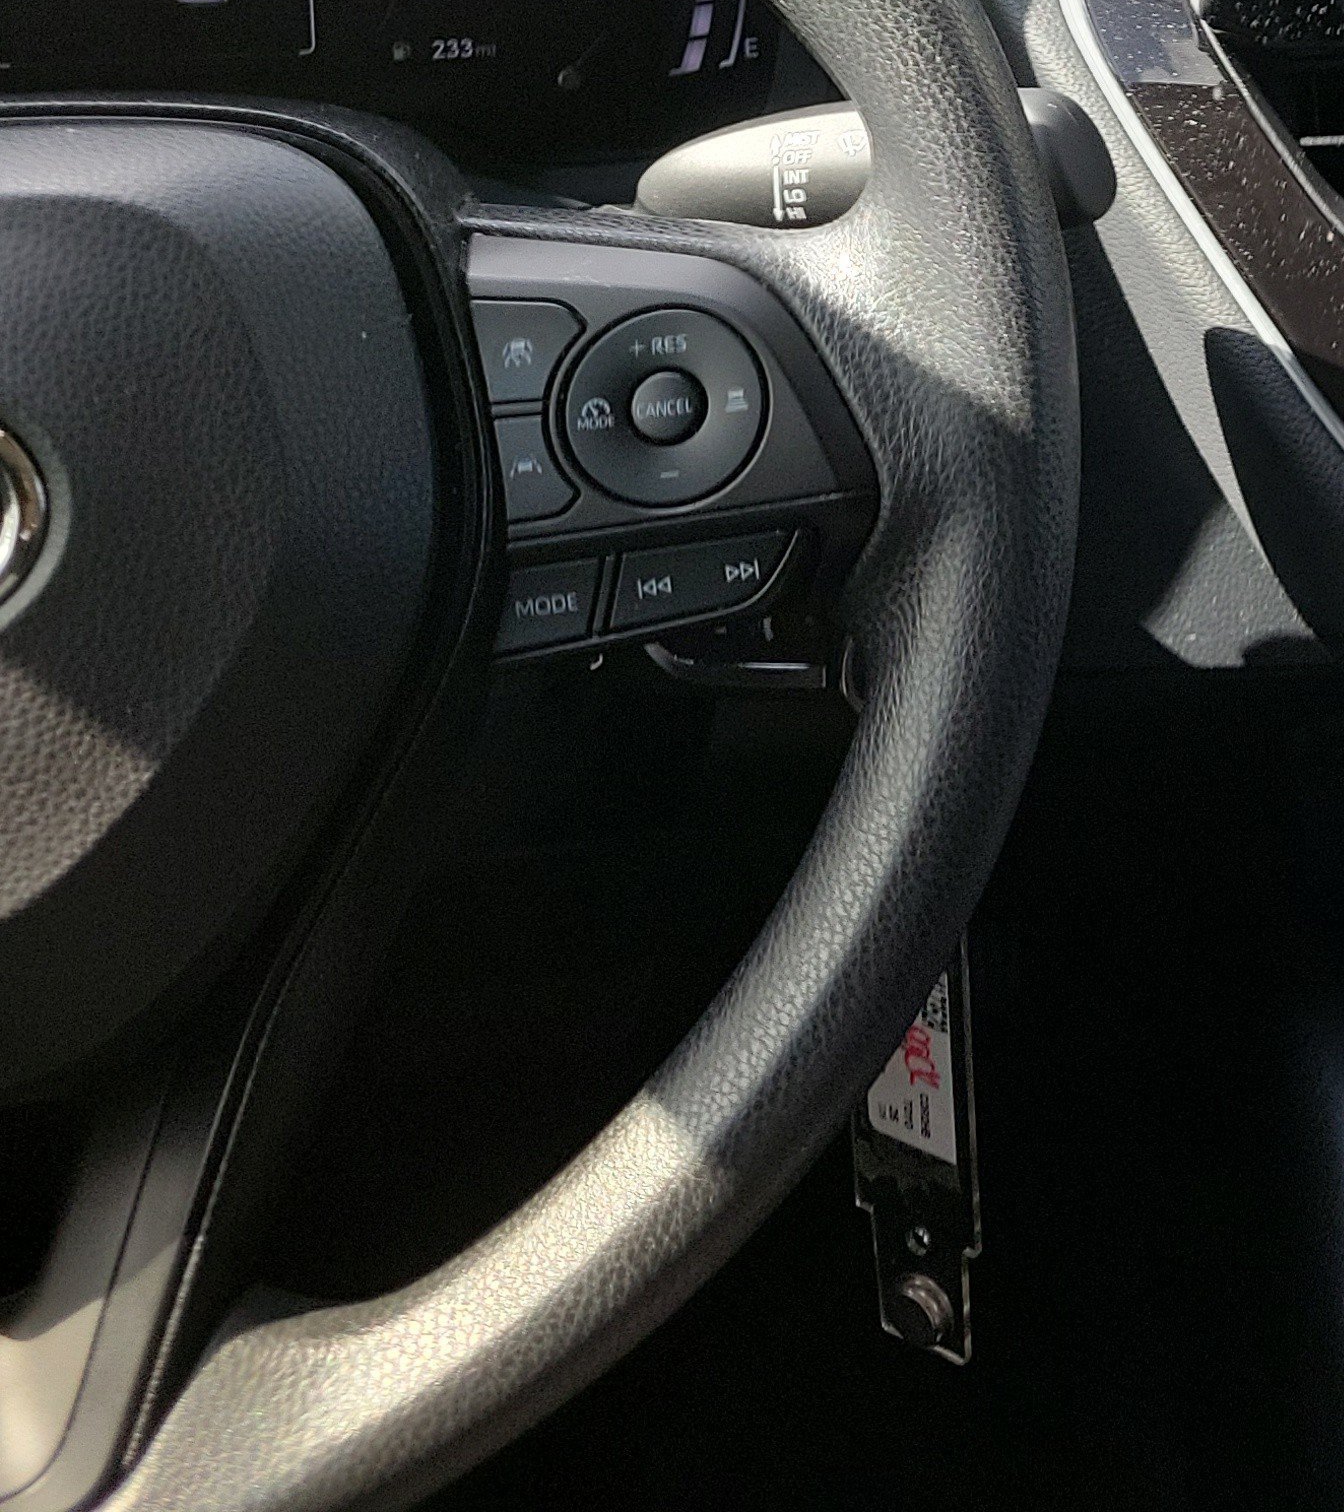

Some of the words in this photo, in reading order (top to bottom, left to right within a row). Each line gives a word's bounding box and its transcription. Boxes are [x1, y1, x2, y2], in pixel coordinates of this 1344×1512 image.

[432, 38, 474, 61] 233
[744, 38, 759, 58] E
[782, 149, 812, 165] OFF
[783, 169, 809, 185] INT
[783, 189, 807, 203] LO
[652, 334, 687, 355] RES
[636, 397, 693, 420] CANCEL
[576, 414, 615, 431] MODE
[515, 591, 579, 618] MODE
